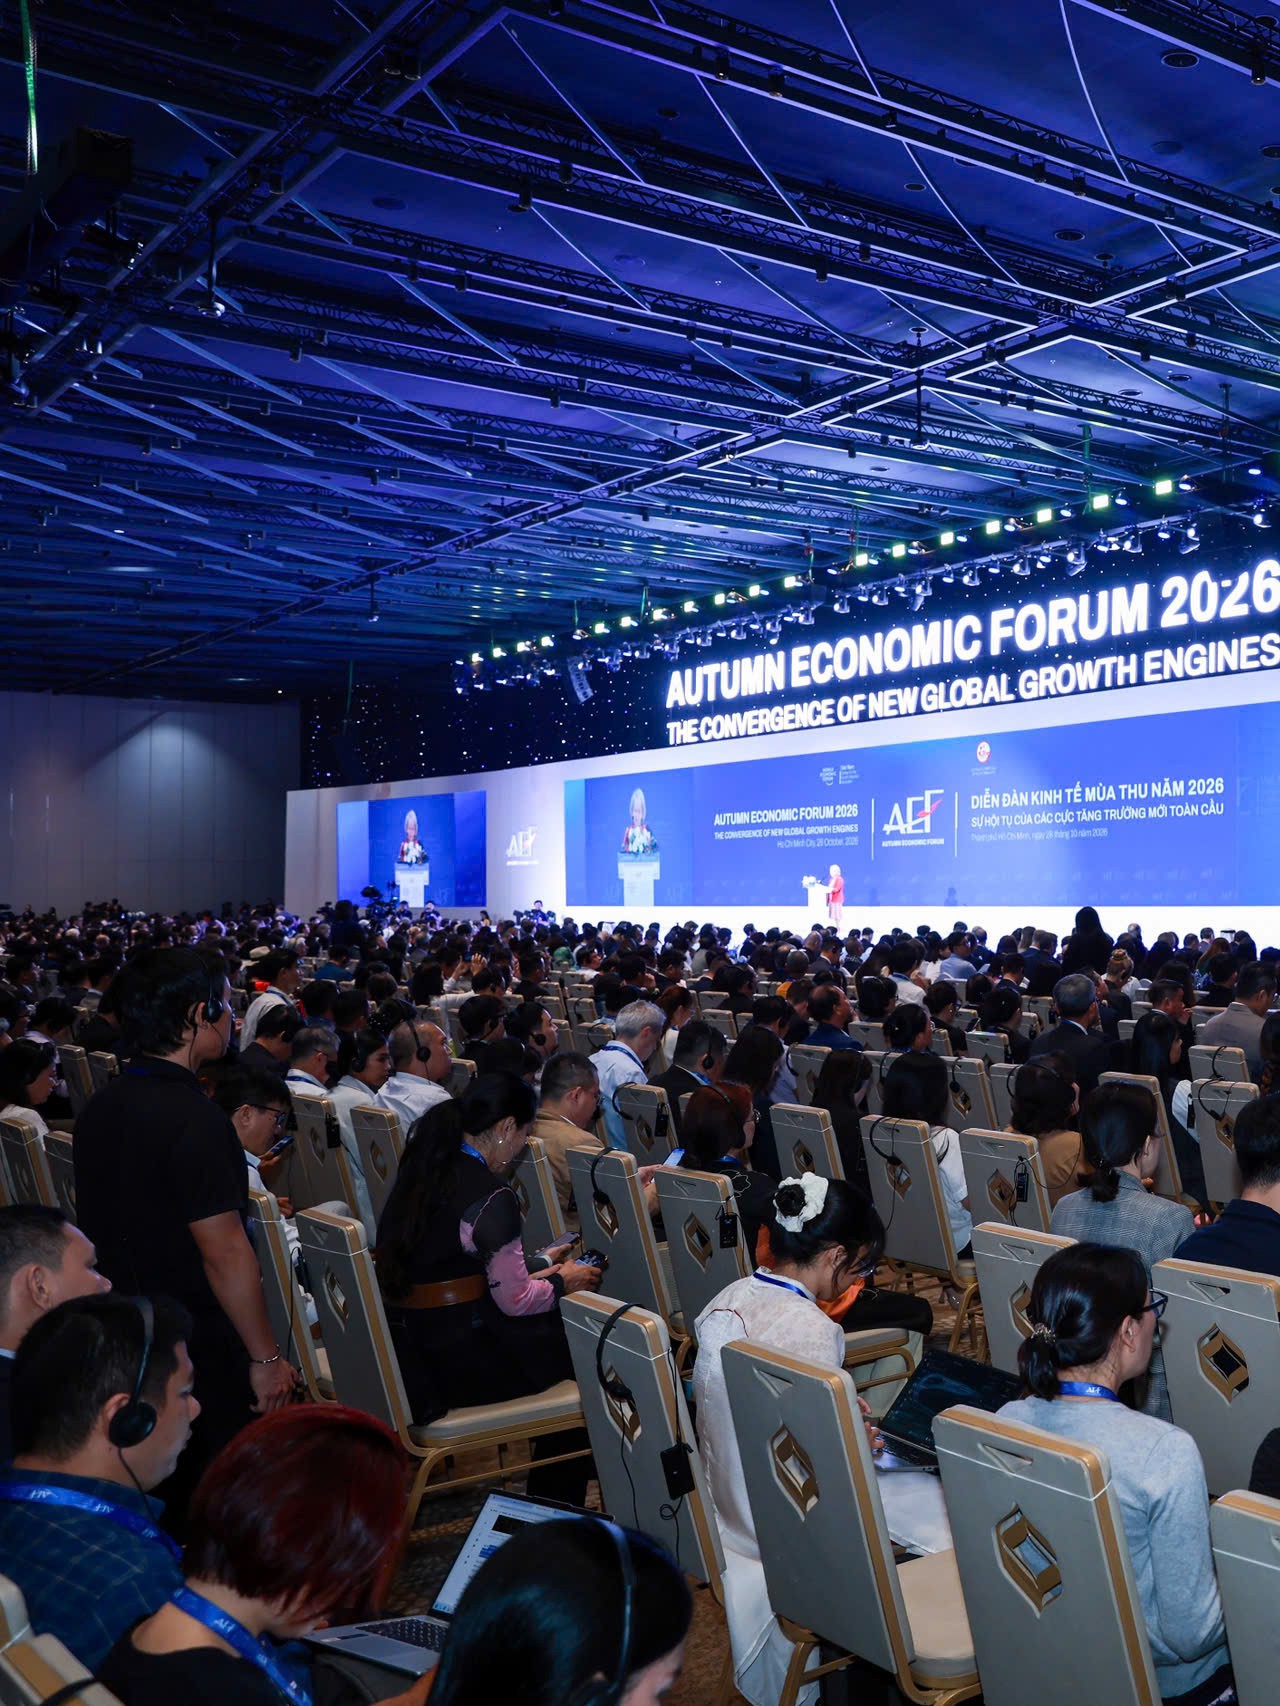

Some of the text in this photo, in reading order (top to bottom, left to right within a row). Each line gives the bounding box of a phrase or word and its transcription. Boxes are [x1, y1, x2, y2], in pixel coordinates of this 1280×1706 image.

[666, 650, 785, 709] AUTUMN
[791, 614, 982, 688] ECONOMIC
[990, 582, 1149, 656] FORUM
[666, 719, 698, 745] THE
[700, 698, 835, 741] CONVERGENCE
[837, 694, 866, 722] OF
[868, 686, 919, 718] NEW
[920, 673, 1015, 712] GLOBAL
[1018, 653, 1137, 700] GROWTH
[971, 777, 1224, 809] DIỄN ĐÀN KINH TẾ MÙA THU NĂM 2026
[714, 803, 858, 826] AUTUMN ECONOMIC FORUM 2026
[882, 789, 944, 835] AEF
[1034, 811, 1053, 825] CÁC
[1076, 808, 1102, 822] TĂNG
[1148, 804, 1168, 818] MỚI
[1169, 802, 1198, 817] TOÀN
[763, 828, 770, 837] OF
[771, 828, 783, 836] NEW
[784, 826, 805, 836] GLOBAL
[806, 825, 831, 835] GROWTH
